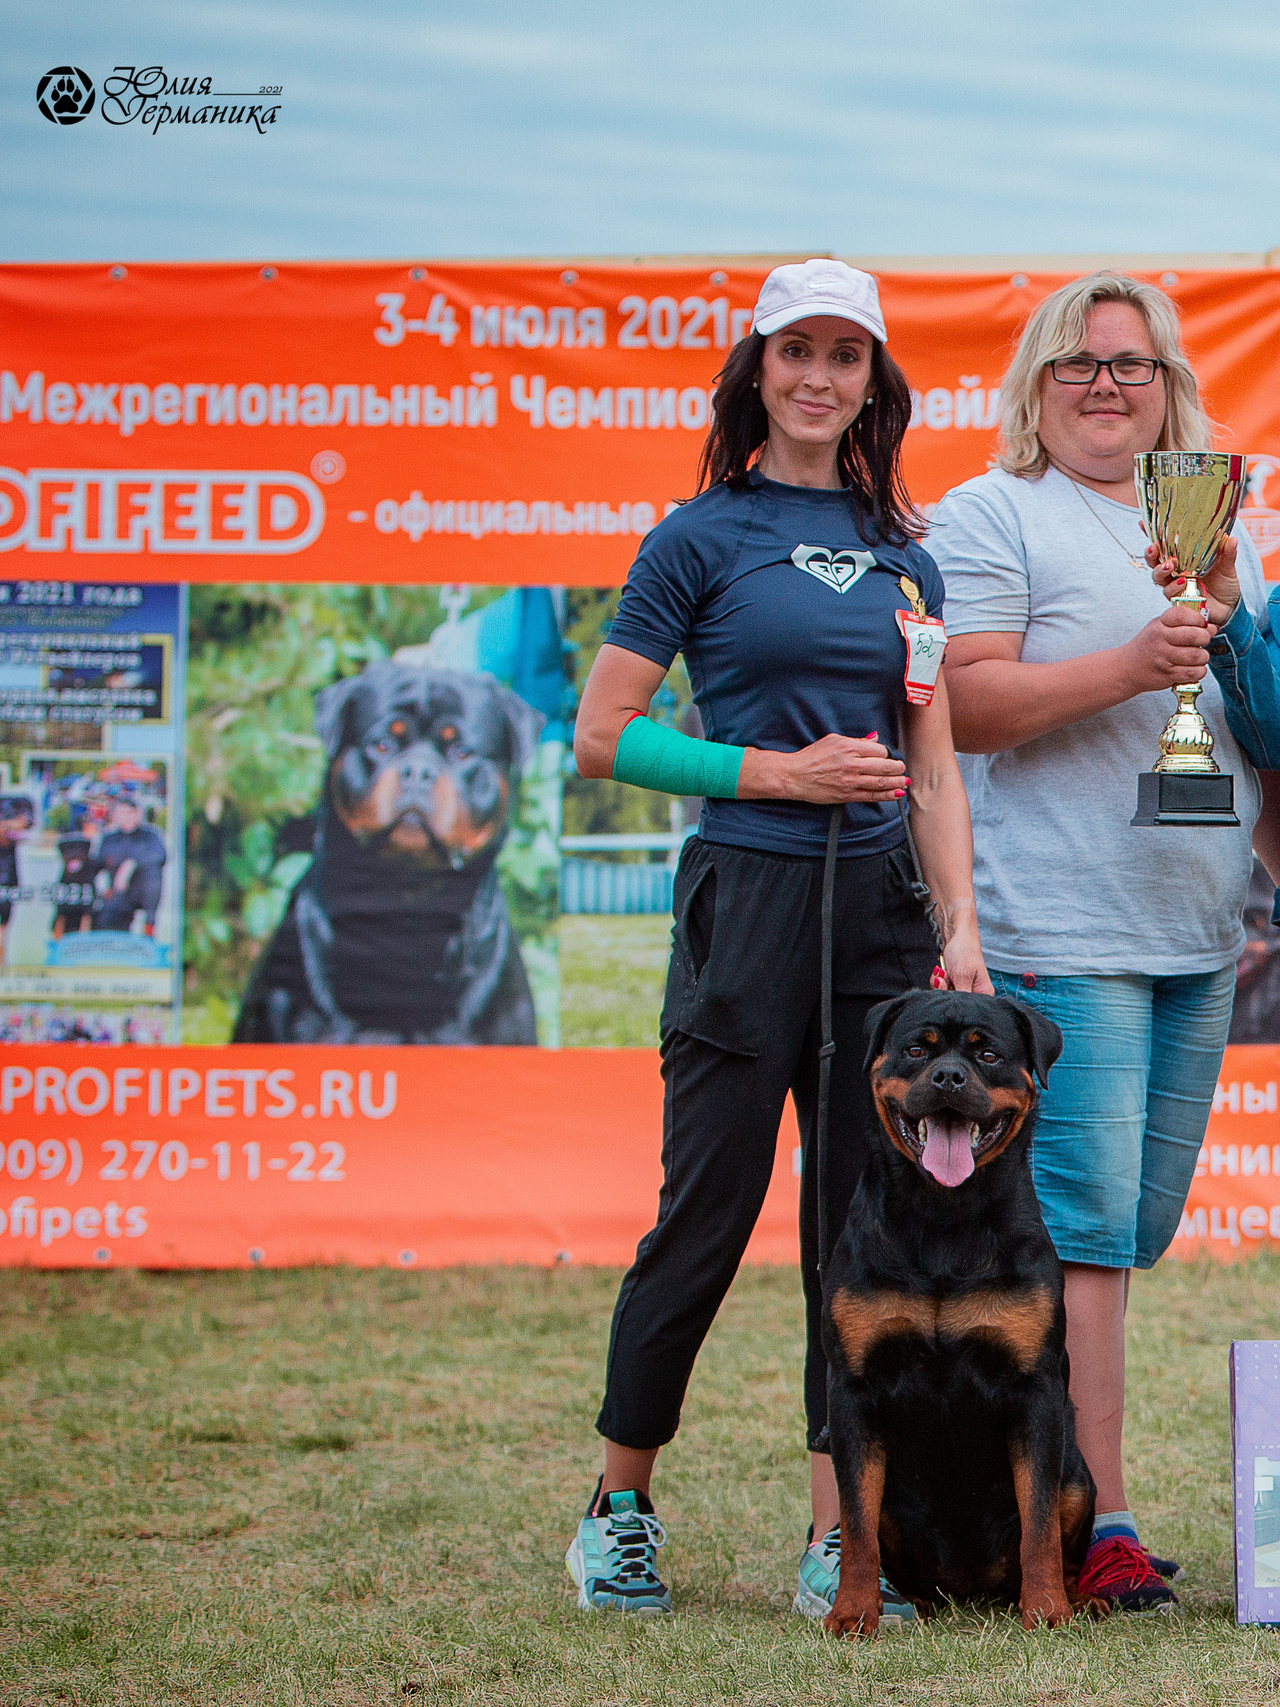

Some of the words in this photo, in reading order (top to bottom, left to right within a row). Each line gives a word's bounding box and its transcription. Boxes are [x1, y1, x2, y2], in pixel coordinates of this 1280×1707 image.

[373, 293, 459, 347] 3-4
[470, 304, 607, 350] июля
[2, 370, 497, 437] Межрегиональный
[509, 374, 716, 431] Чемпио
[374, 492, 658, 540] официальные
[0, 1137, 83, 1186] 09)
[99, 1139, 347, 1182] 270-11-22
[0, 1195, 148, 1248] fipets
